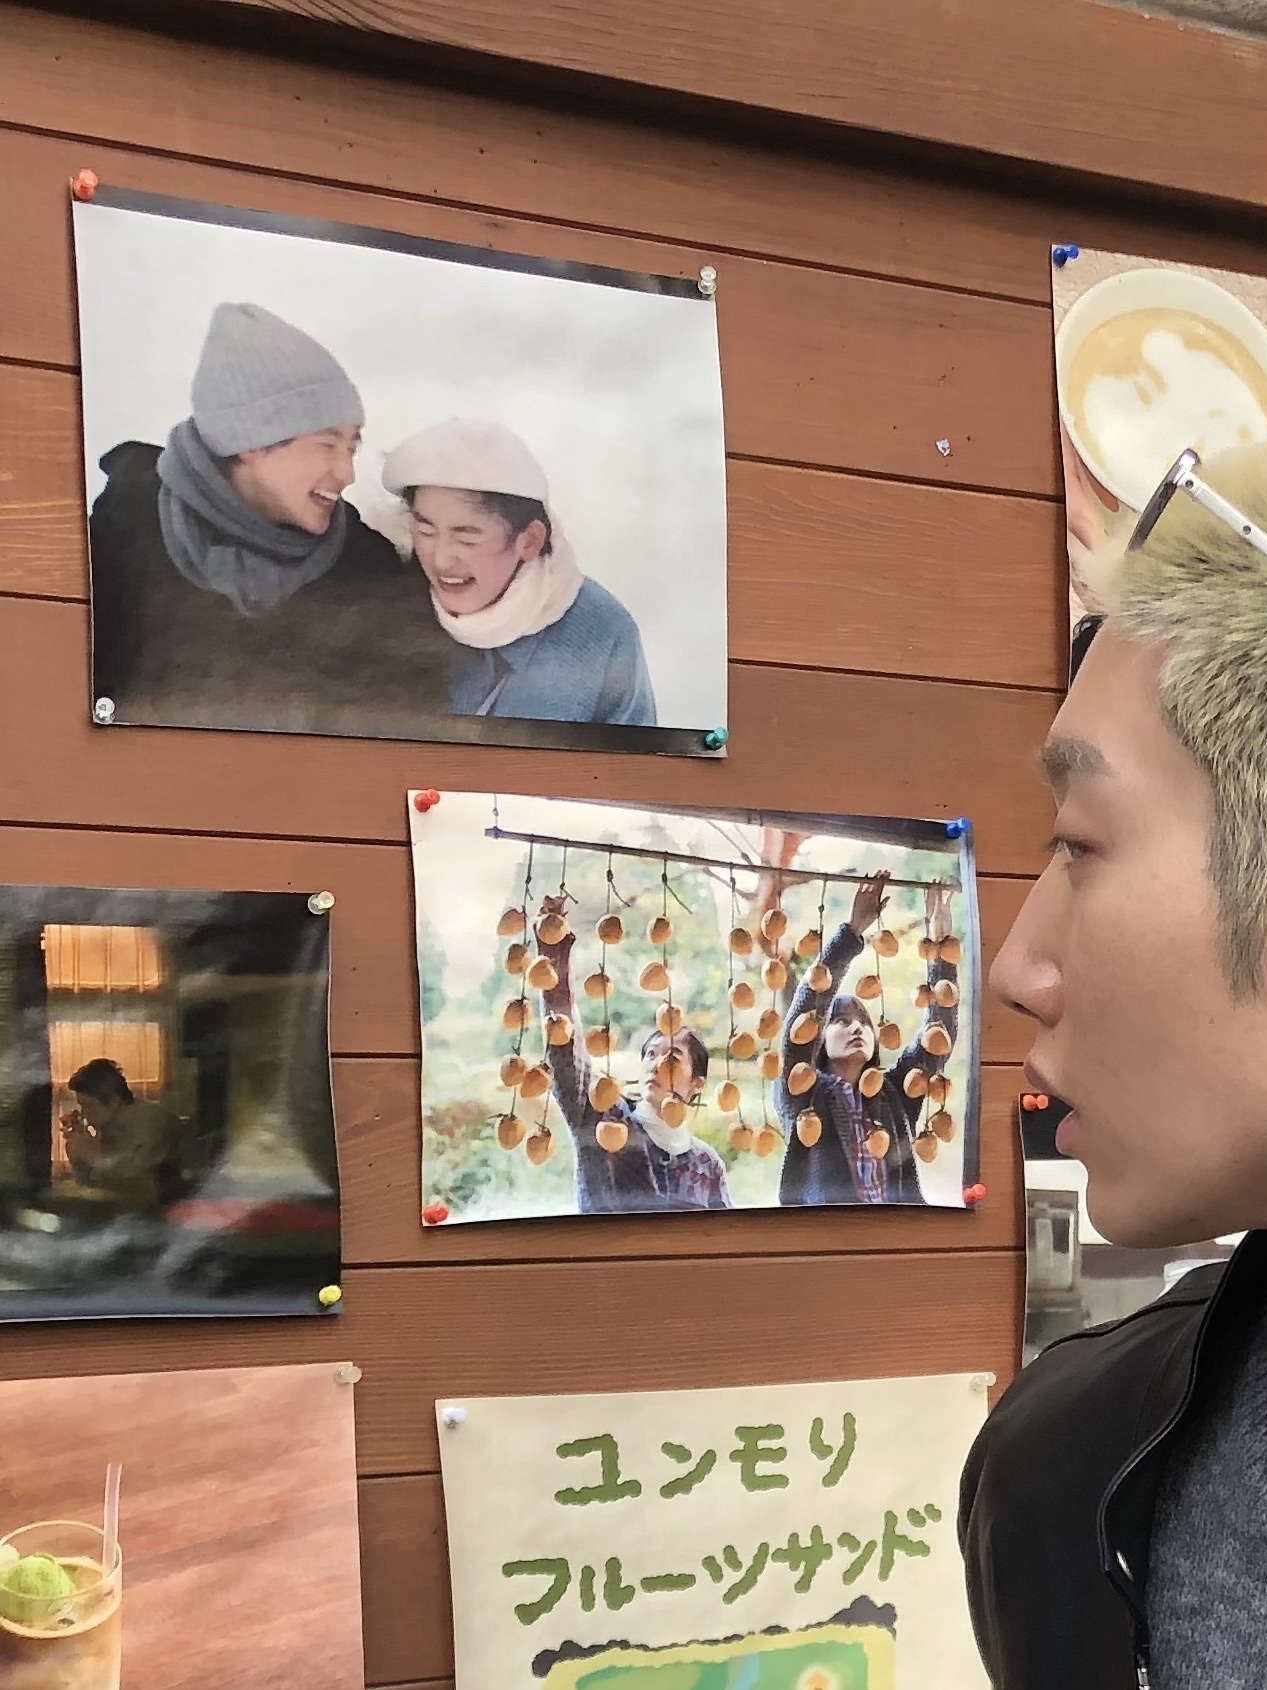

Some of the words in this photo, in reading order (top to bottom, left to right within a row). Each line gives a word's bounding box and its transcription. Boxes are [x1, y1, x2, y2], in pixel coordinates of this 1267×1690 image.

[554, 1411, 857, 1506] ユンモリ
[501, 1503, 942, 1626] フルーツサンド
